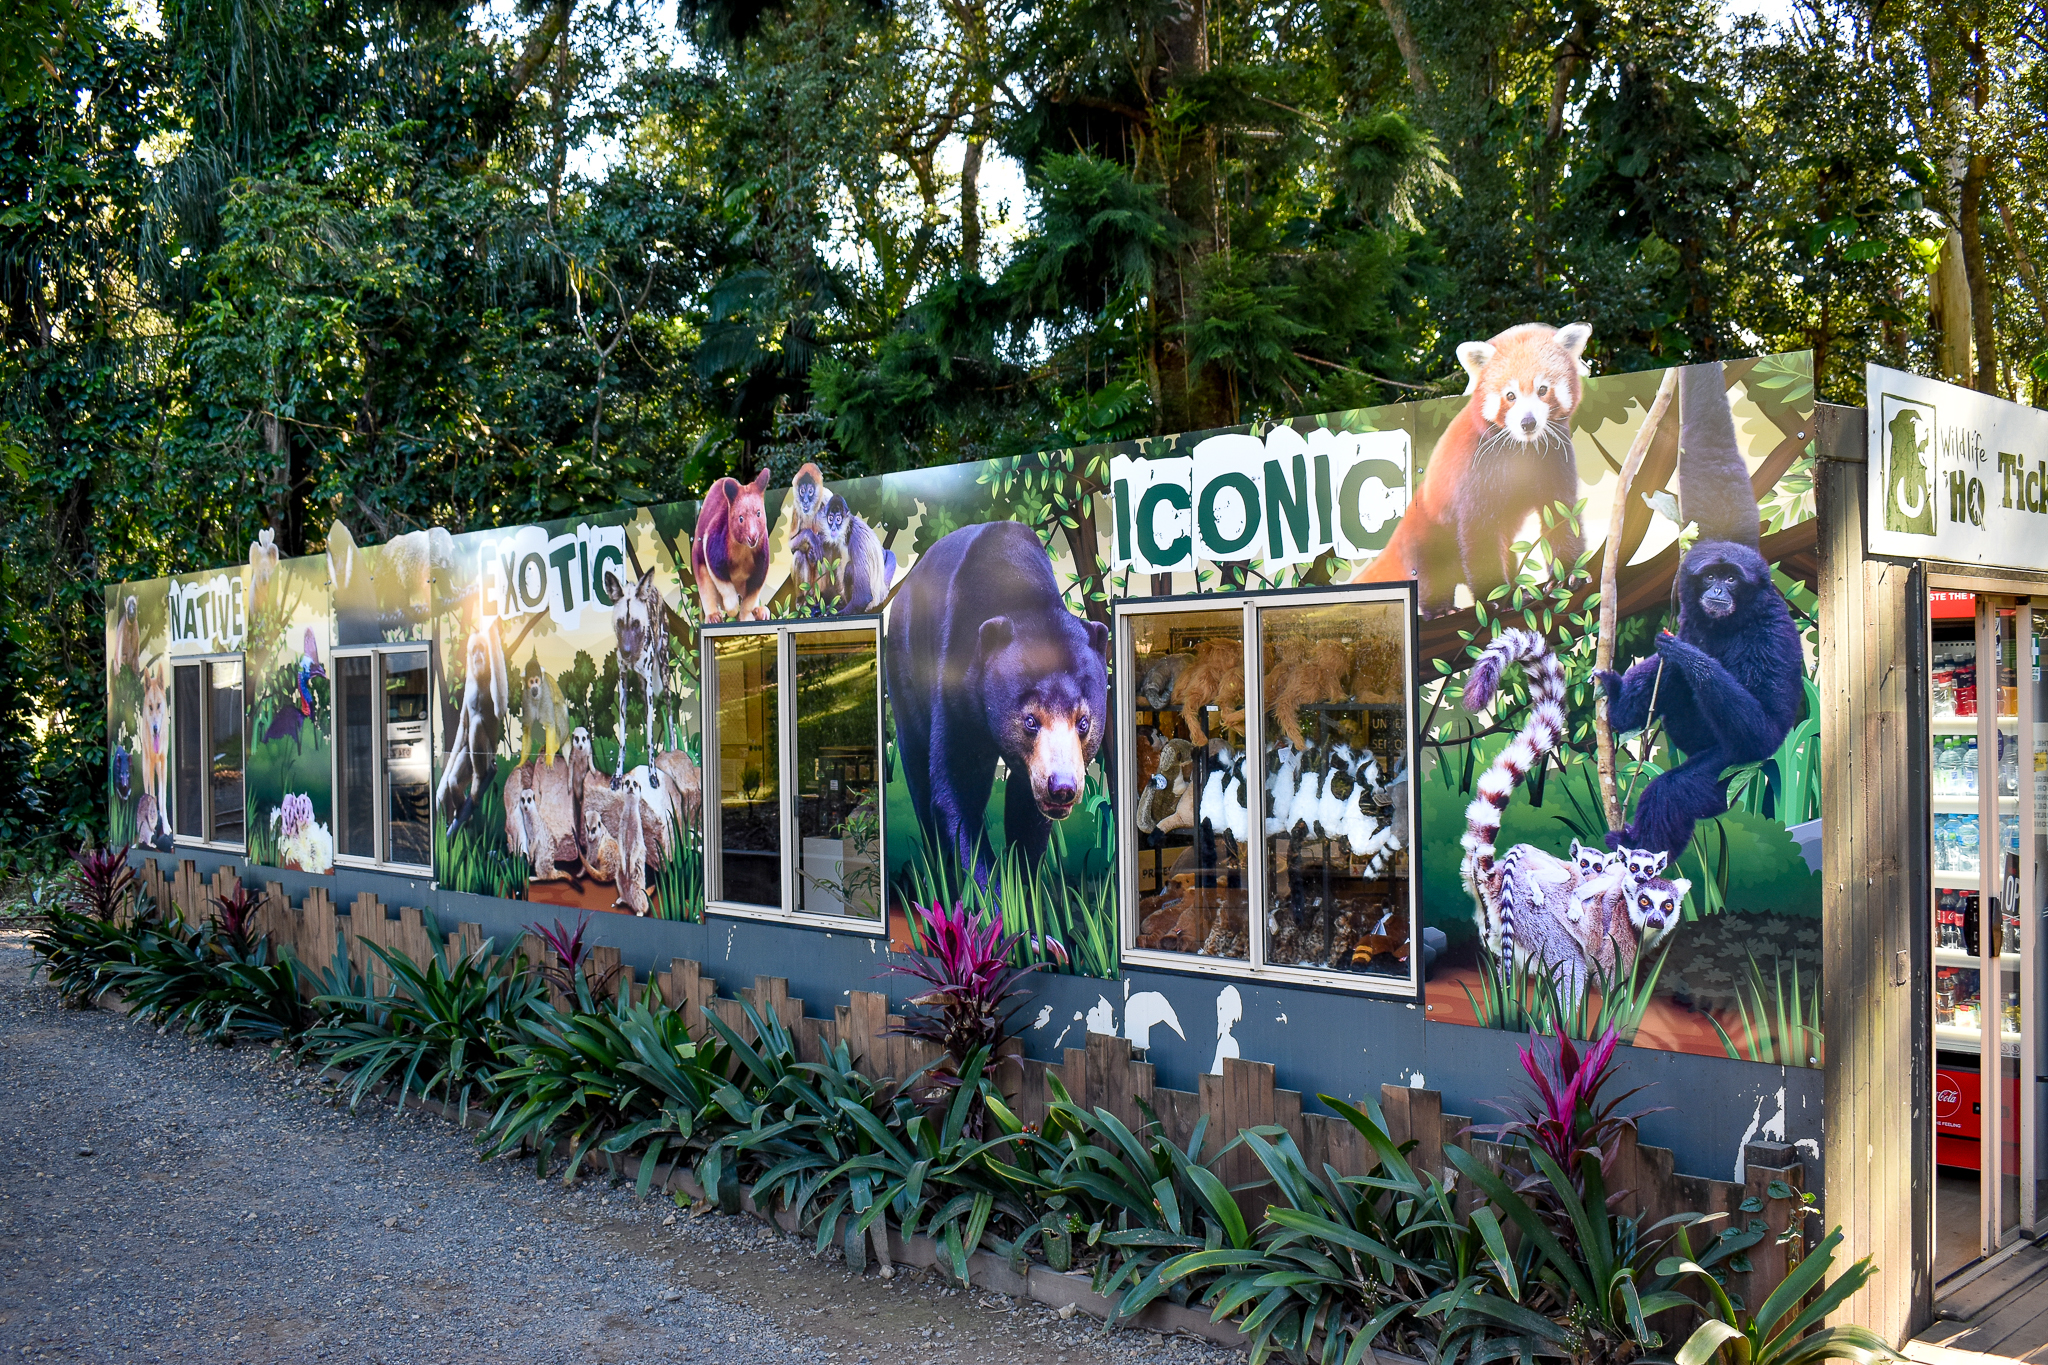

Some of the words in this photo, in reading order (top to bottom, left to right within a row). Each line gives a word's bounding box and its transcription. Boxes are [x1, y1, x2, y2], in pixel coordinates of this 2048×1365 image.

[1941, 425, 1988, 471] Wildlife
[1114, 454, 1407, 567] ICONIC
[1949, 469, 1985, 527] HQ
[481, 541, 624, 616] EXOTIC
[1949, 592, 1967, 600] THE
[169, 581, 243, 642] NATIVE
